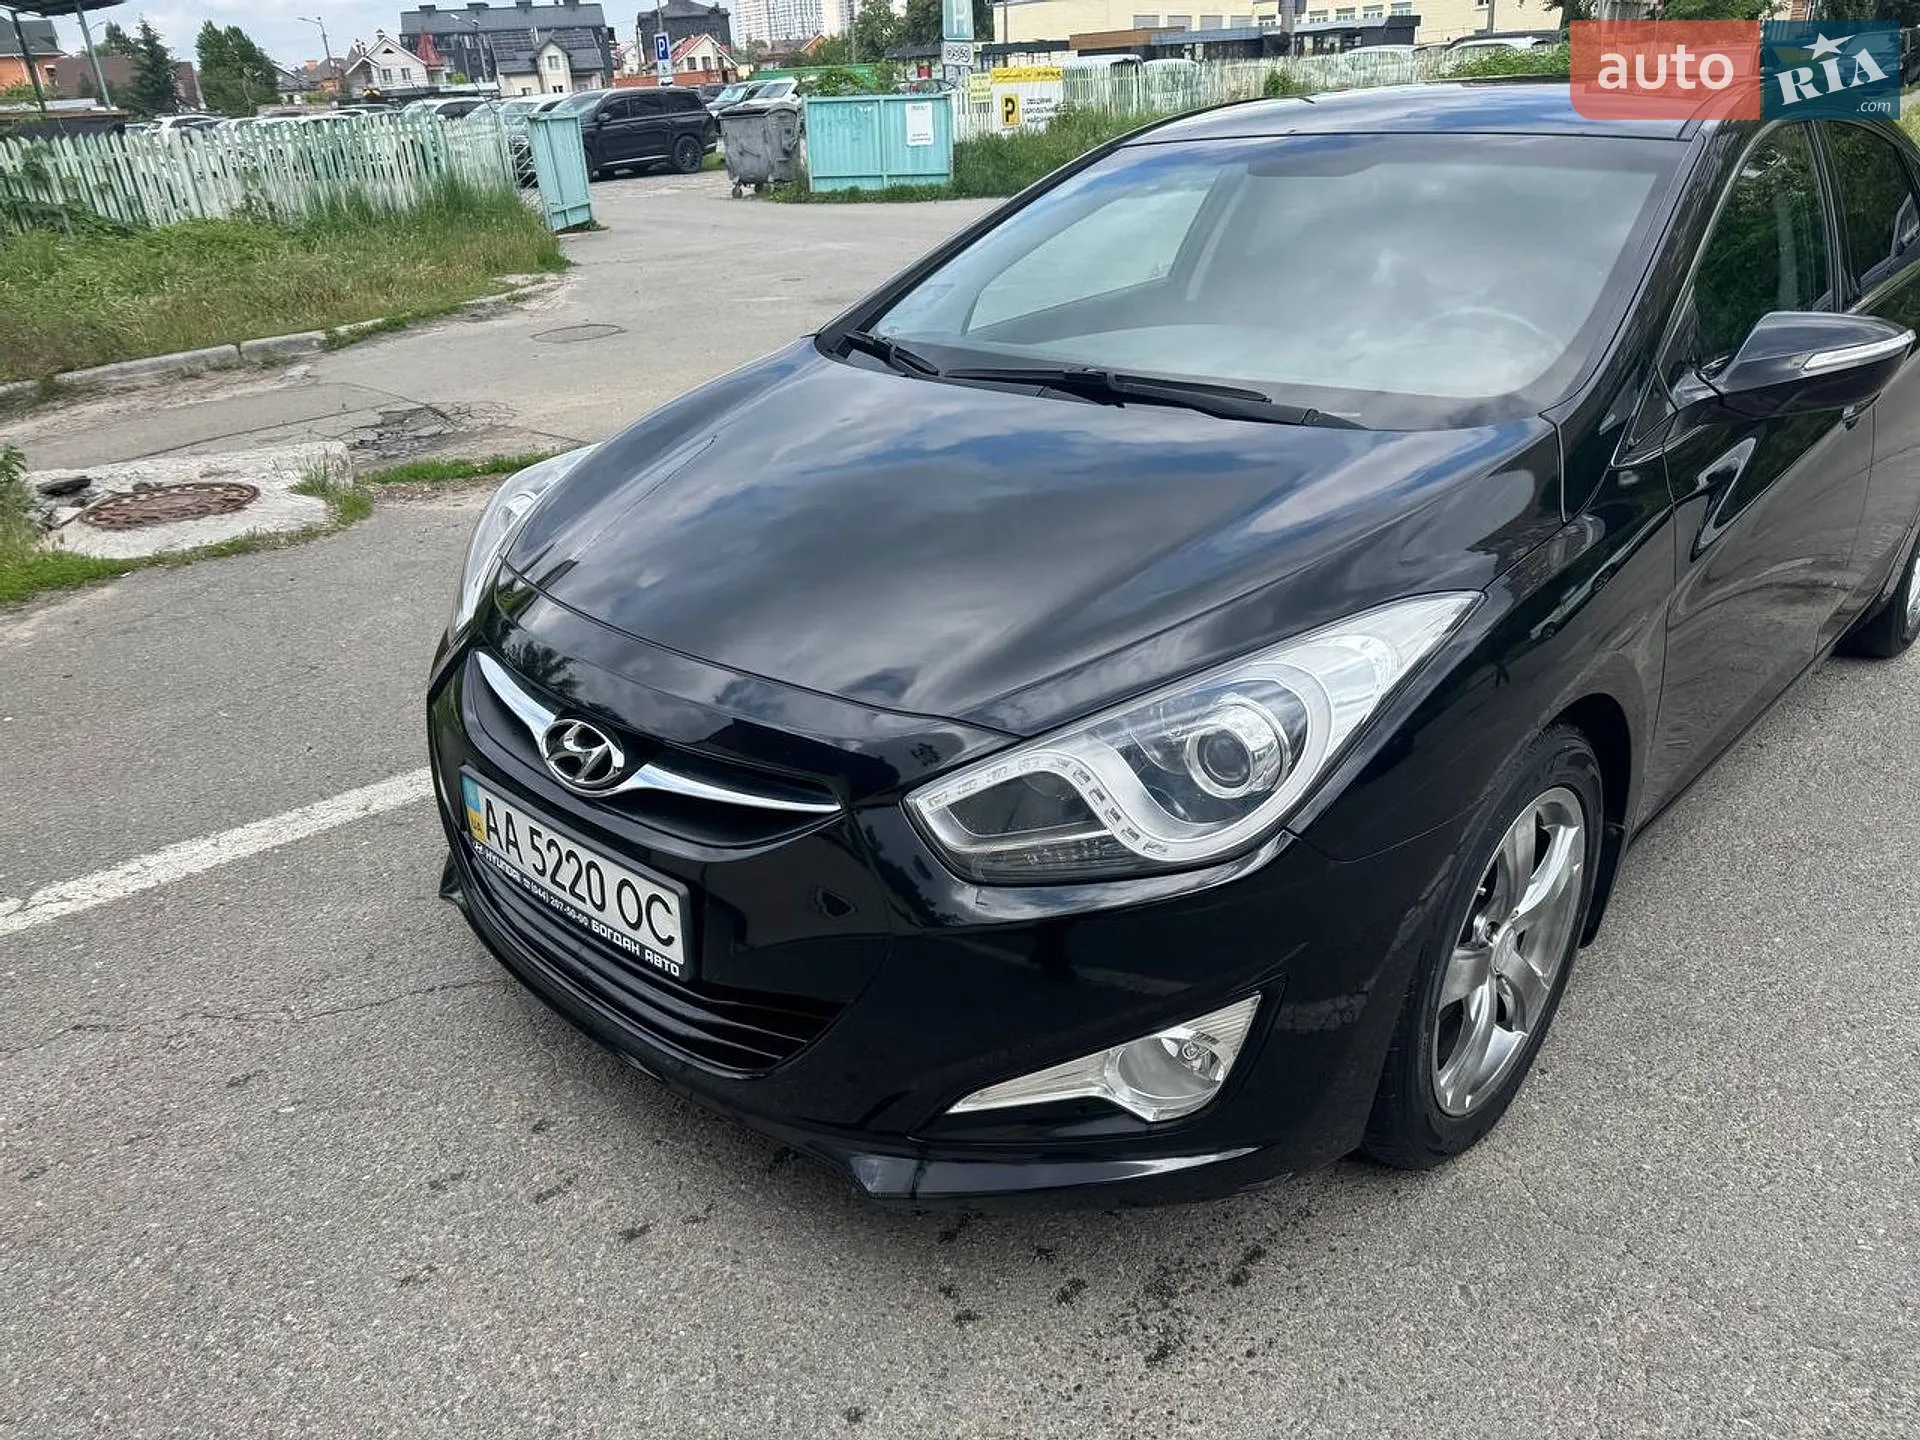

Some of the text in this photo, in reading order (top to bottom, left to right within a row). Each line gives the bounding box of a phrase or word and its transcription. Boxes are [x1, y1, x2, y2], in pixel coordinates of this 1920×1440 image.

[658, 38, 666, 58] P
[1005, 97, 1015, 122] P
[471, 815, 483, 833] UA
[485, 798, 676, 947] AA 5220 OC
[591, 919, 640, 956] БОГДАН
[644, 949, 680, 977] АВТО
